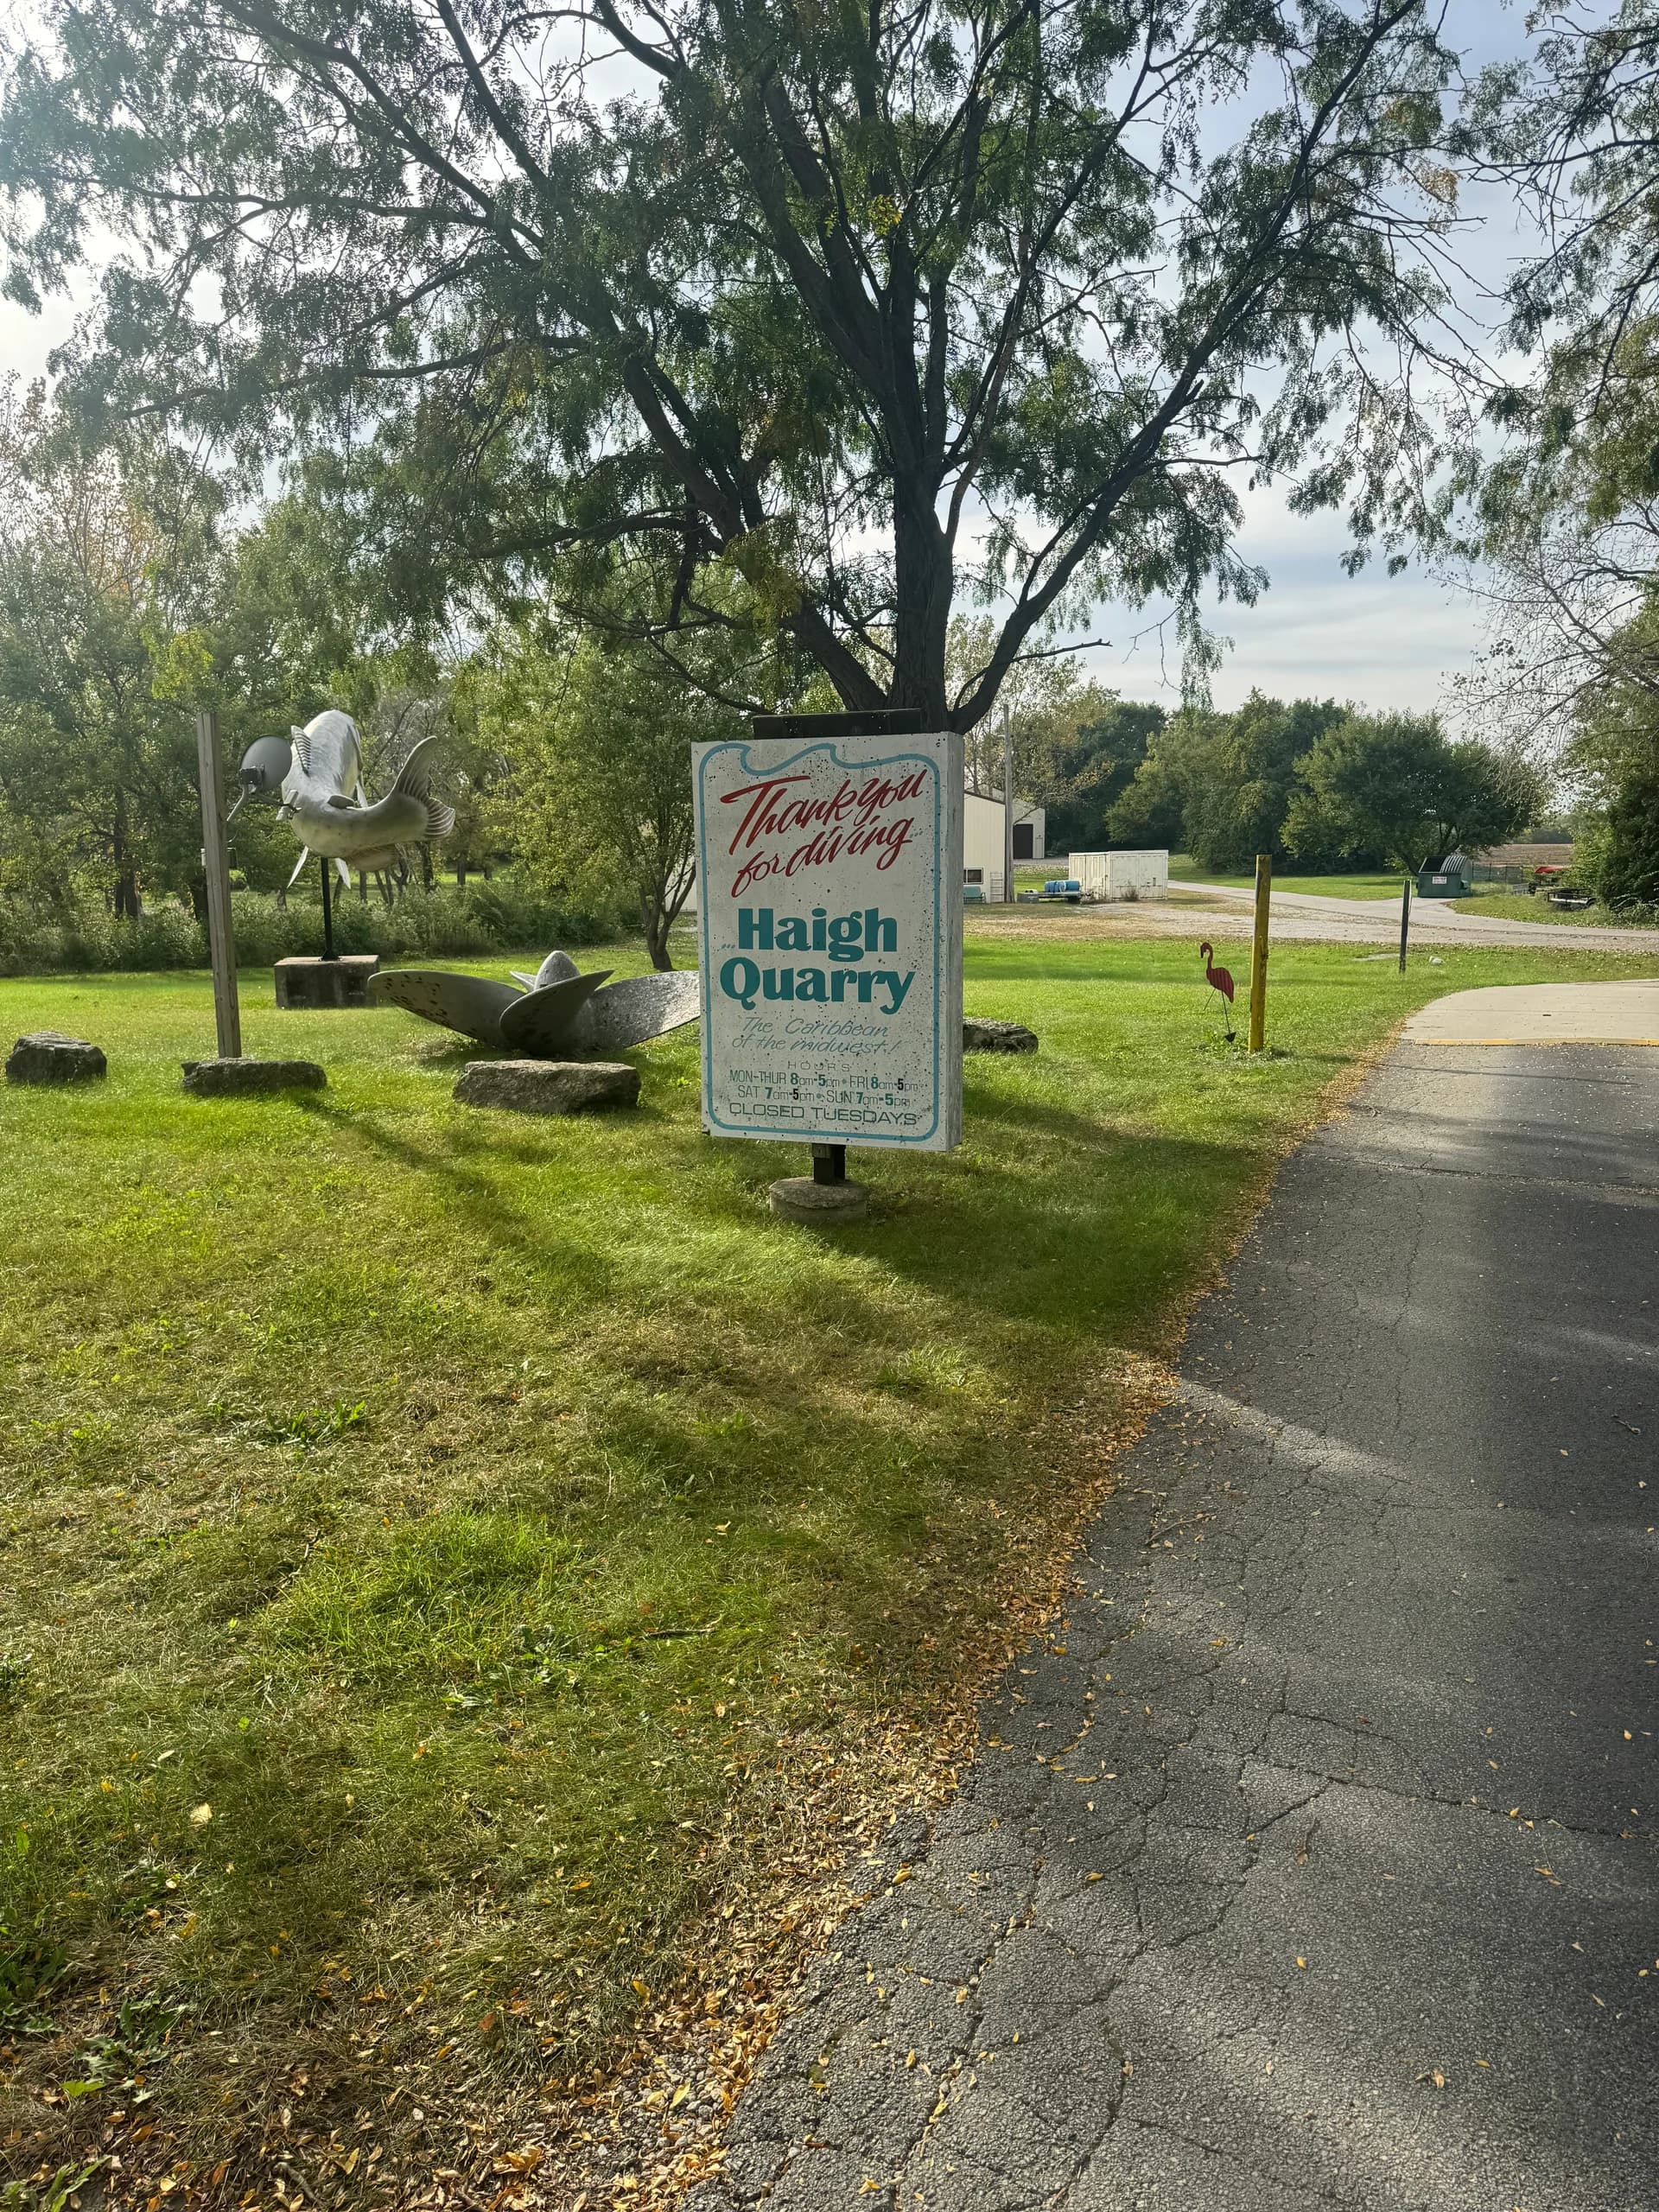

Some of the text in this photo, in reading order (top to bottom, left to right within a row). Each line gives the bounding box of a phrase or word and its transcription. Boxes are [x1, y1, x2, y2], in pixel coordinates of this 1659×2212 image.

[720, 775, 857, 855] Thank
[731, 850, 785, 898] for
[720, 957, 915, 1014] Quarry
[742, 1016, 889, 1037] The Caribbean
[732, 1033, 756, 1048] of
[756, 1034, 786, 1051] the
[787, 1060, 851, 1072] HOURS
[849, 1074, 869, 1090] FRI
[738, 1084, 761, 1100] SAT
[826, 1090, 853, 1104] SUN
[729, 1102, 917, 1126] CLOSED TUESDAYS
